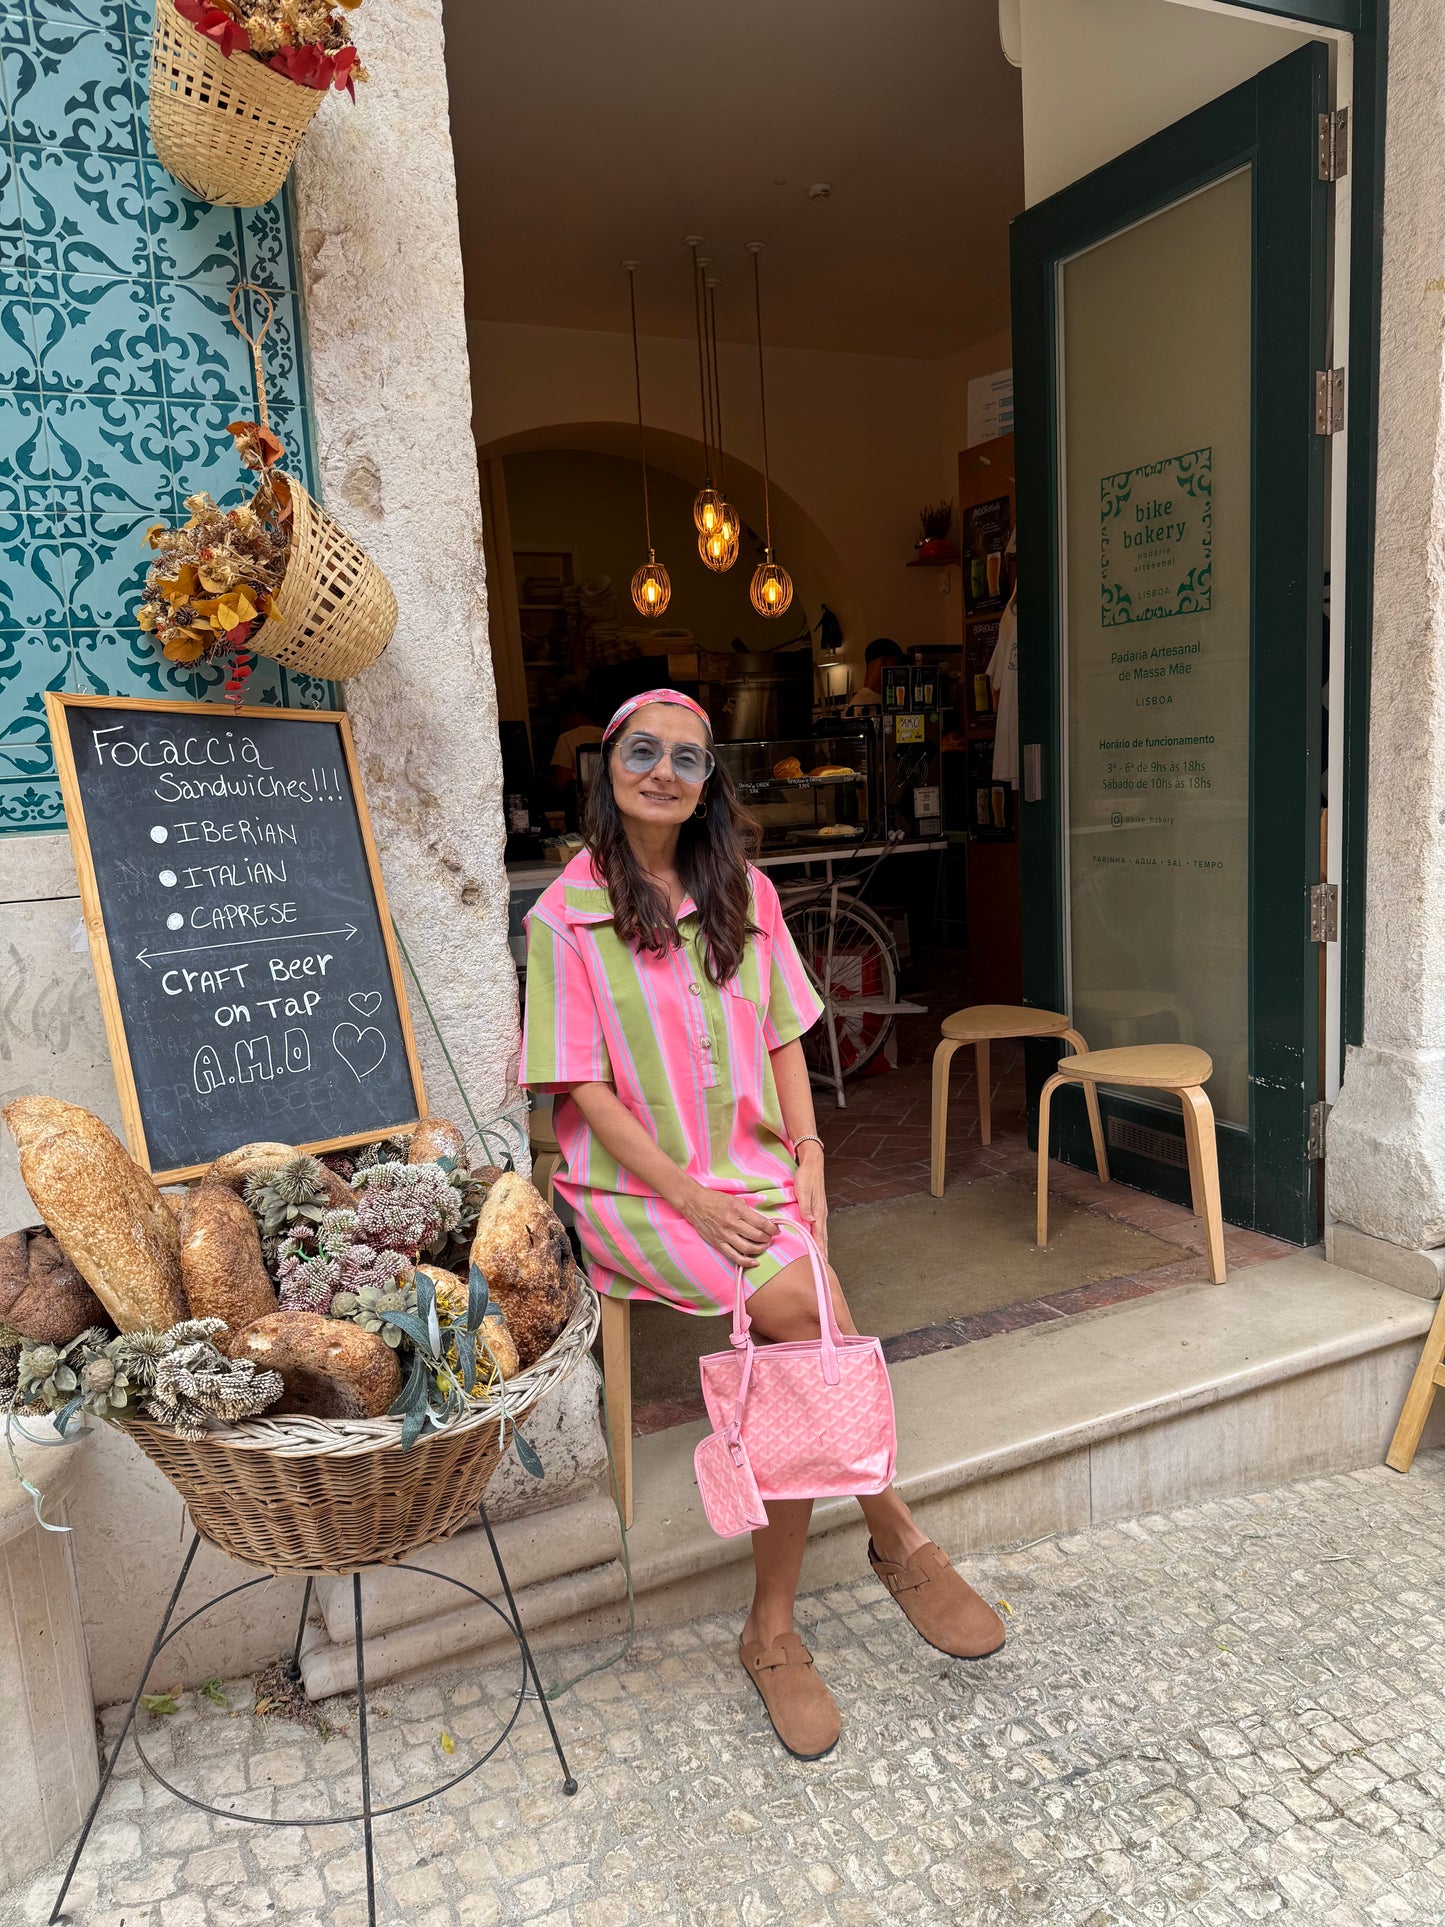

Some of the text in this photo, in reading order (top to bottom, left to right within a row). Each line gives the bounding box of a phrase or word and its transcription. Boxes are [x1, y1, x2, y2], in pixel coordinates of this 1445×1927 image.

[1135, 500, 1173, 523] bike
[1123, 522, 1186, 549] bakery
[1137, 547, 1171, 561] padaria
[1133, 557, 1176, 572] artesanal
[1138, 587, 1170, 600] LISBOA
[1111, 641, 1201, 664] Padaria Artesanal
[1118, 663, 1192, 681] de Massa Mãe
[1135, 695, 1173, 707] LISBOA
[92, 725, 275, 770] Focaccia
[1099, 735, 1215, 750] Horário de funcionamento
[1137, 762, 1148, 773] de
[1150, 761, 1167, 773] 9hs
[1184, 760, 1206, 772] 18hs
[154, 767, 343, 803] Sandwiches!!!
[1102, 778, 1134, 789] Sábado
[1136, 778, 1148, 789] de
[1151, 777, 1172, 789] 10hs
[1189, 777, 1212, 789] 18hs
[1092, 856, 1126, 864] FARINHA
[1167, 859, 1183, 867] SAL
[1193, 860, 1223, 869] TEMPO
[190, 902, 297, 929] CAPRESE
[269, 954, 334, 982] Beer
[214, 1004, 251, 1027] on
